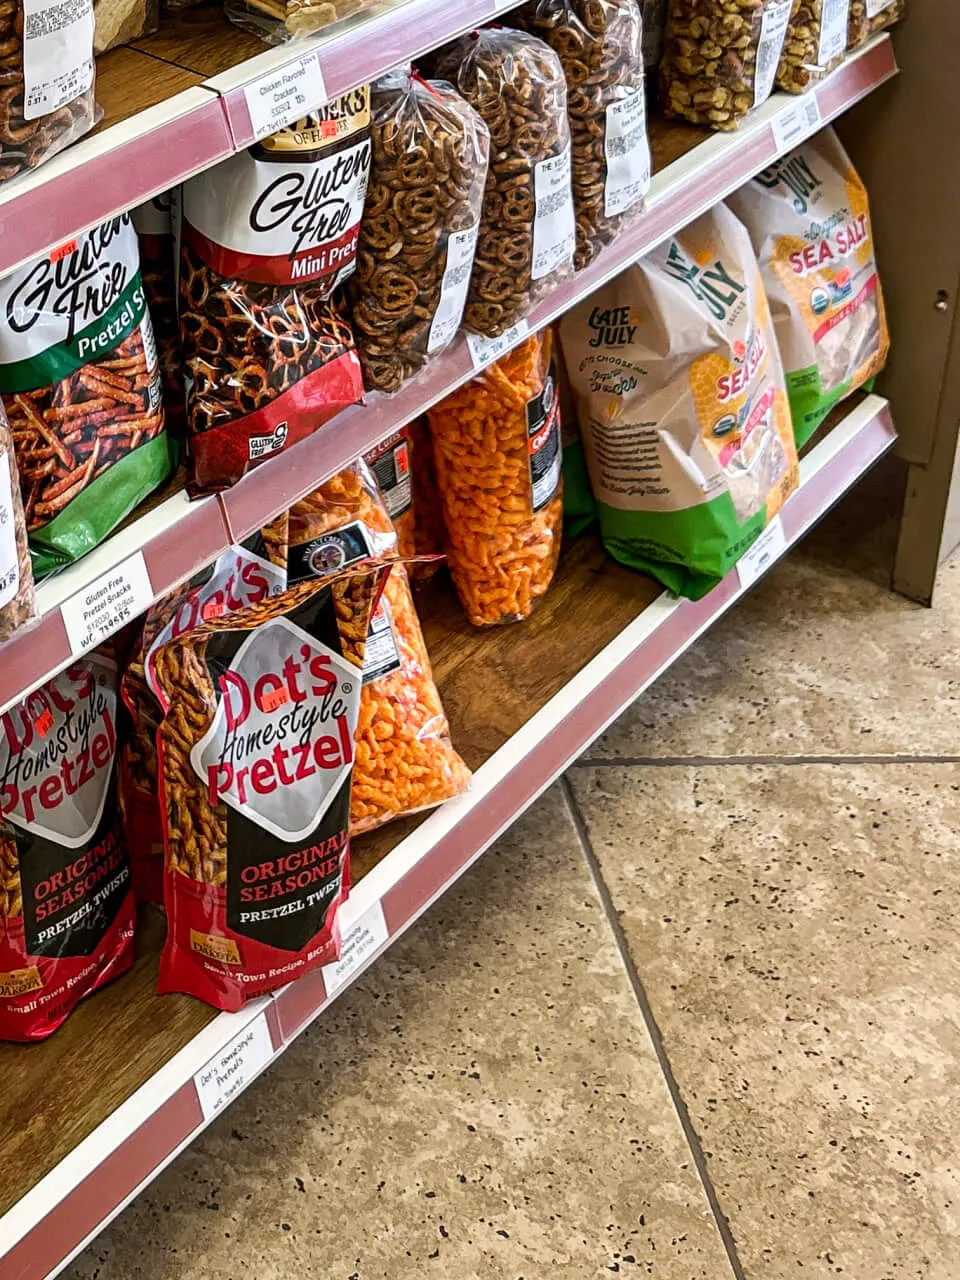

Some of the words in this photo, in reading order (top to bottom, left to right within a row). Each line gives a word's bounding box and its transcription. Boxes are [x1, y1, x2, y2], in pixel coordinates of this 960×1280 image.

[249, 142, 370, 232] Gluten
[288, 197, 352, 261] Free
[788, 246, 832, 275] SEA
[836, 215, 867, 258] SALT
[291, 254, 325, 280] Mini
[328, 240, 357, 268] Pret
[55, 261, 127, 344] Free
[589, 306, 631, 327] LATE
[78, 308, 135, 358] Pretzel
[589, 326, 637, 347] JULY
[83, 600, 107, 620] Pretzel
[107, 584, 131, 603] Snacks
[85, 586, 108, 605] Gluten
[108, 576, 123, 590] Free
[218, 644, 336, 732] Dot's
[0, 684, 107, 791] Homestyle
[217, 682, 348, 770] Homestyle
[240, 855, 340, 902] SEASONE
[240, 900, 305, 922] PRETZEL
[307, 877, 340, 906] TWIST
[37, 902, 92, 943] PRETZEL
[192, 942, 241, 963] DAKOTA
[236, 972, 265, 983] Town
